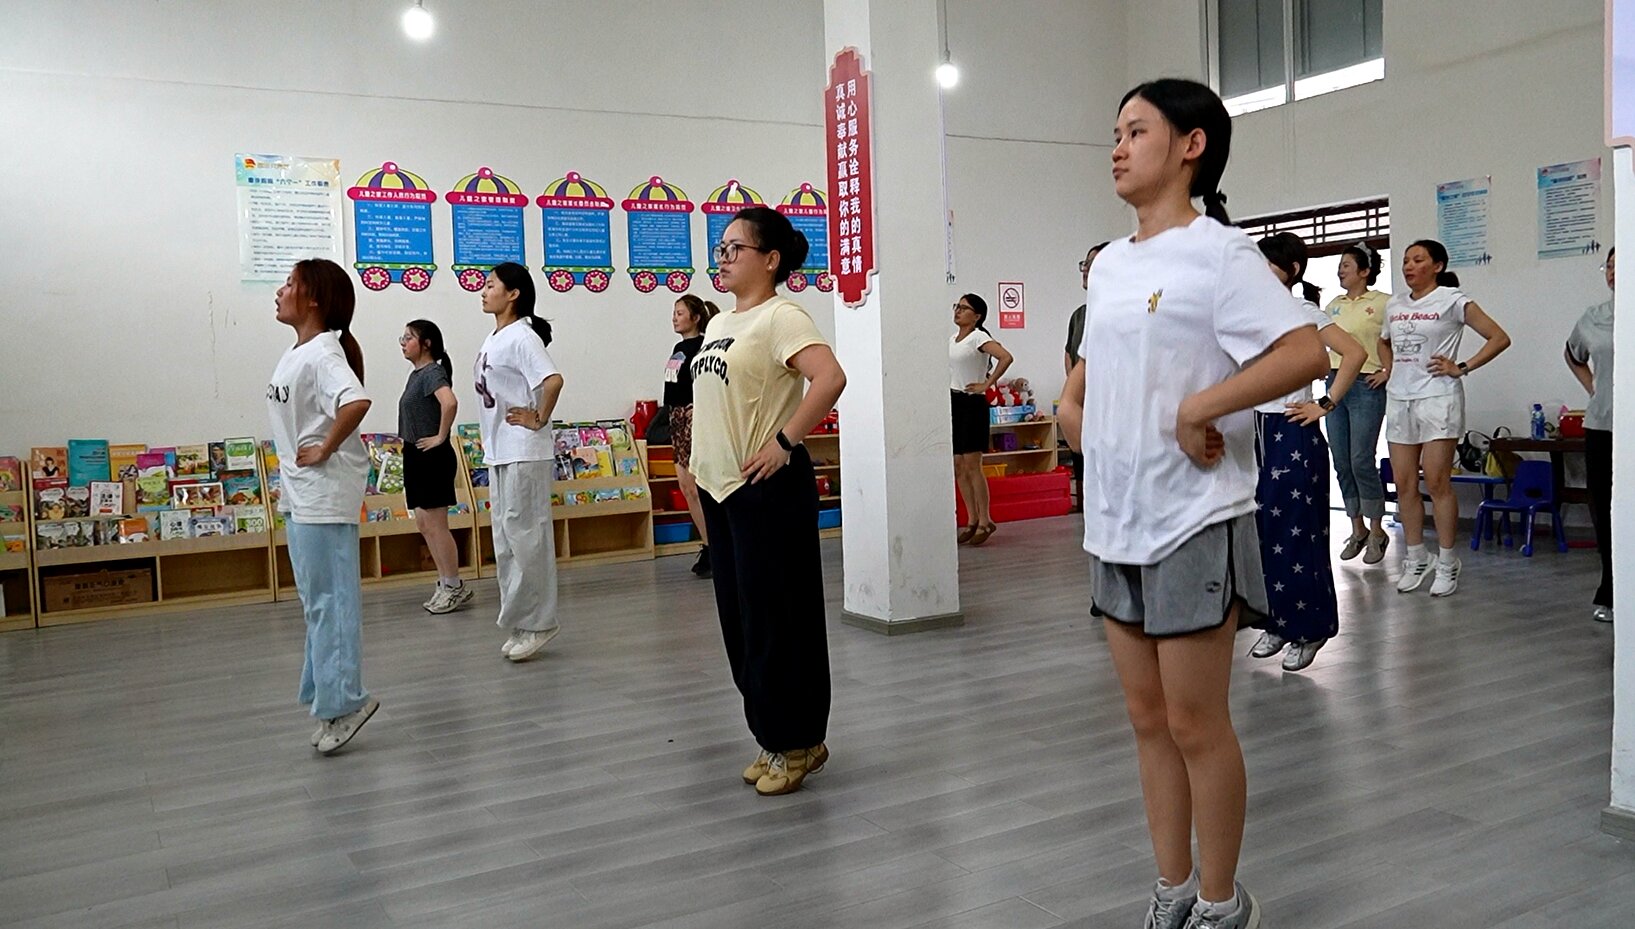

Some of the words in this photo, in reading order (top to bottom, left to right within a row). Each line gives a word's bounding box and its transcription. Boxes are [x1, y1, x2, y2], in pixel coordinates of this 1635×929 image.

[836, 83, 851, 275] 真诚奉献赢取你的满意
[847, 79, 863, 274] 用心服务诠释我的真情
[1411, 312, 1440, 321] Beach
